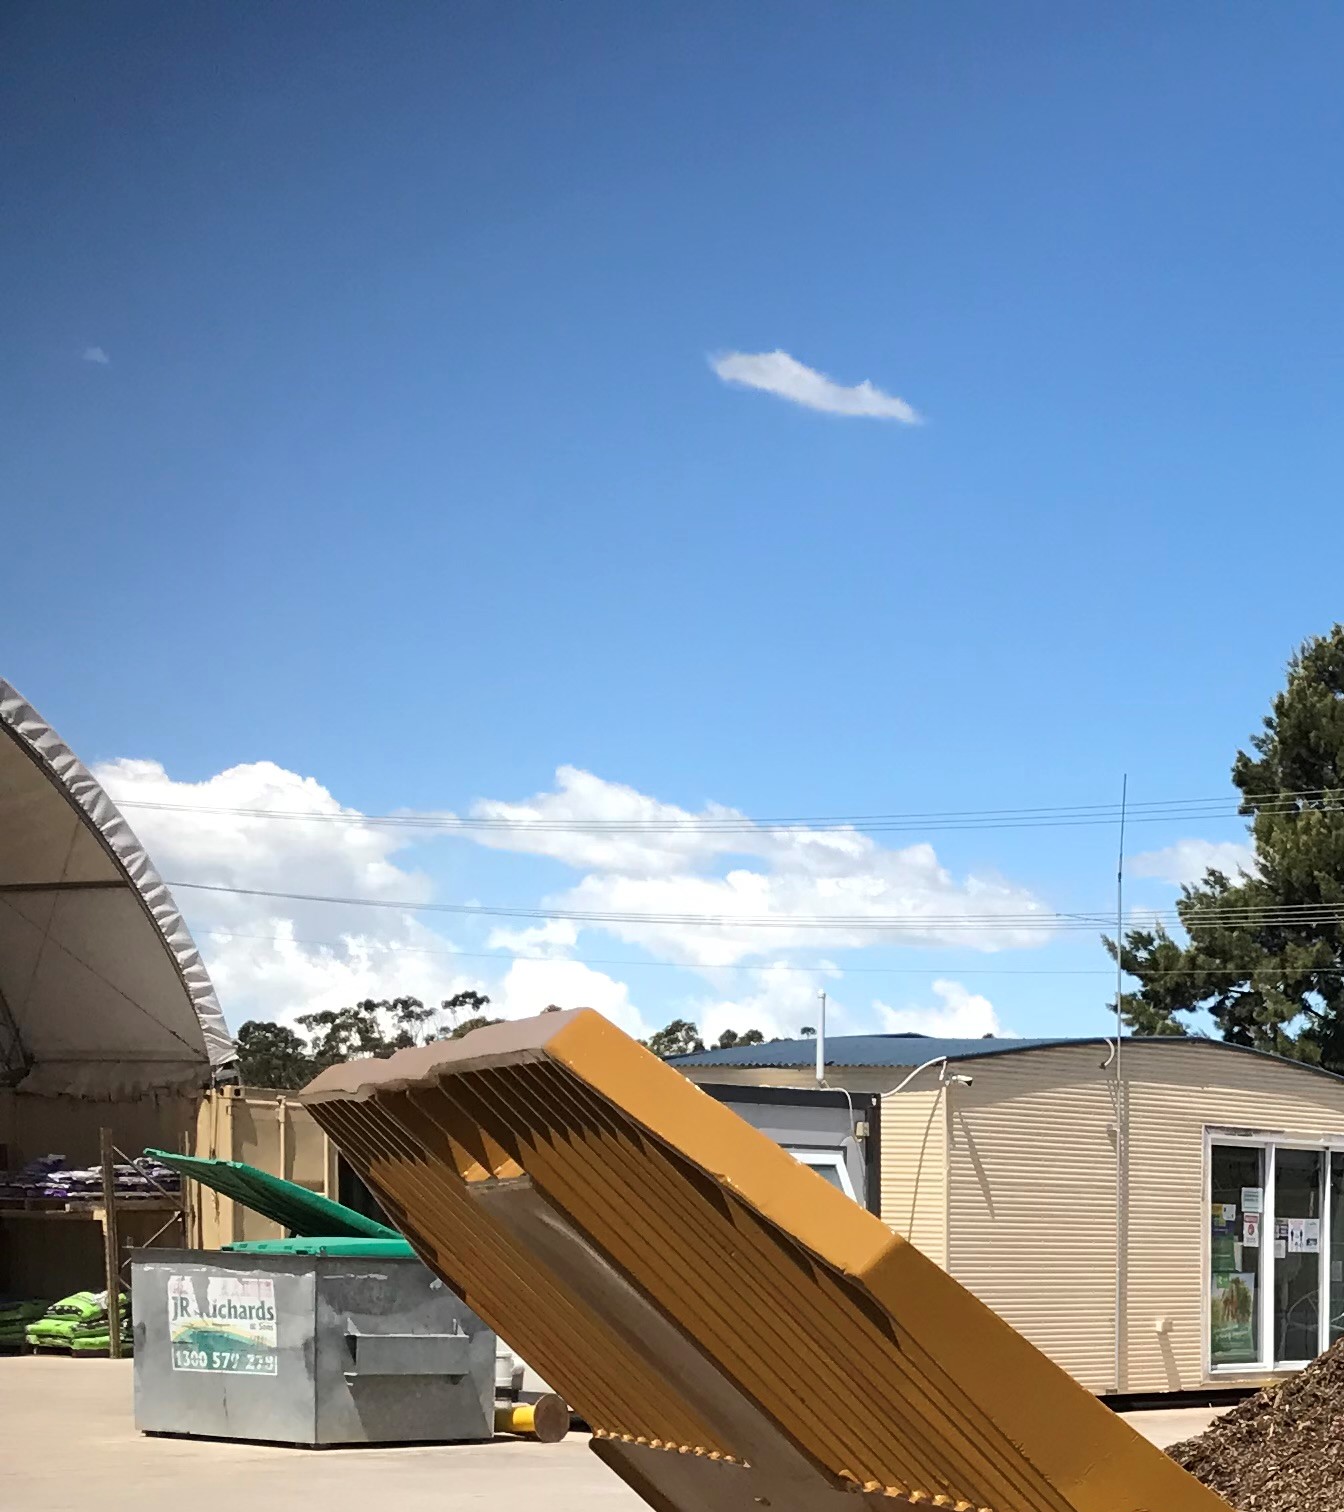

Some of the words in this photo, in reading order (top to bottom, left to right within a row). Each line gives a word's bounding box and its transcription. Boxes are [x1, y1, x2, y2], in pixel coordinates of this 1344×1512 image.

[171, 1296, 191, 1321] JR
[200, 1298, 275, 1321] ichards
[176, 1350, 208, 1367] 1300
